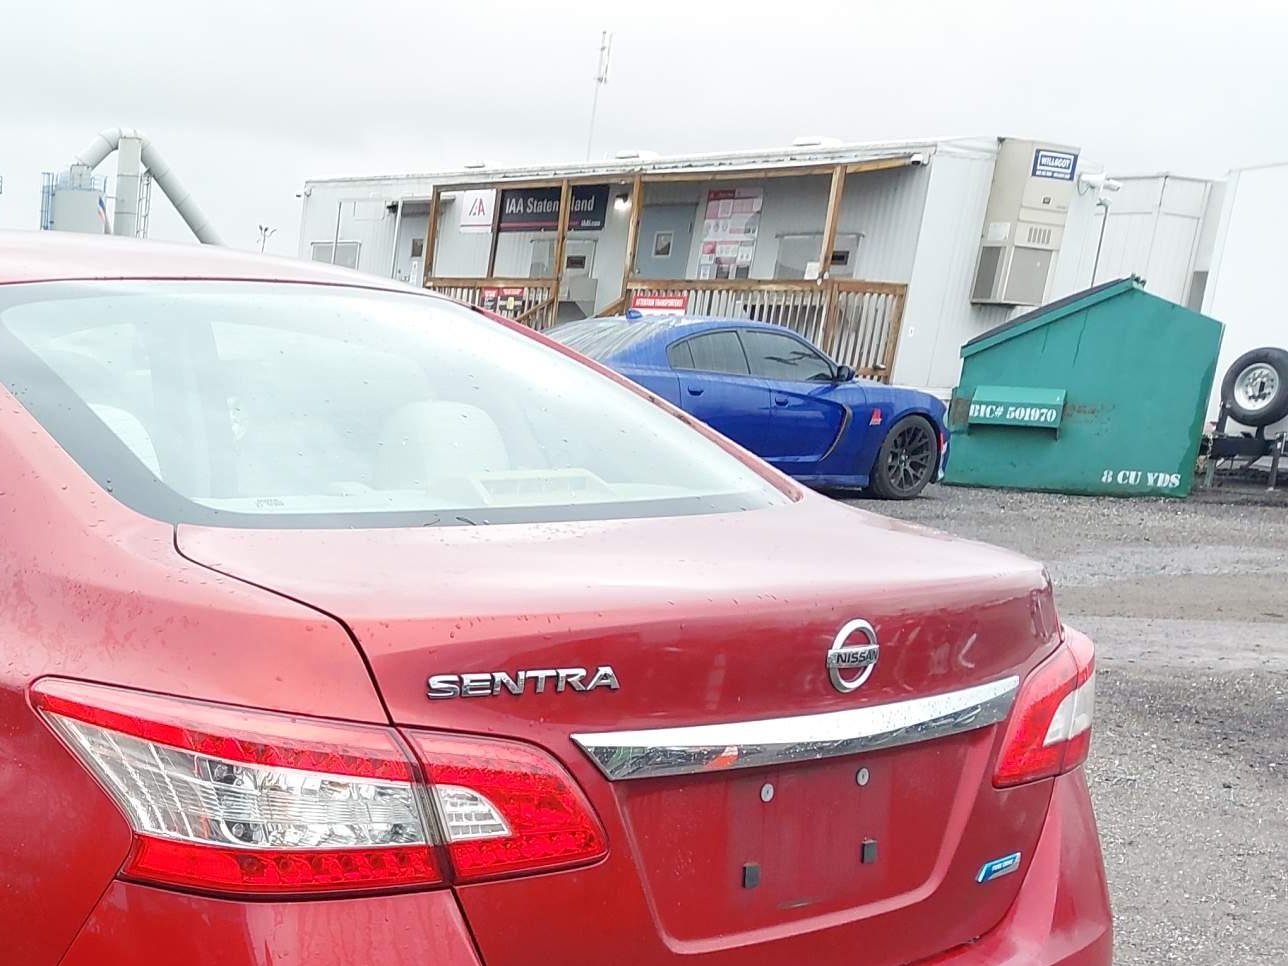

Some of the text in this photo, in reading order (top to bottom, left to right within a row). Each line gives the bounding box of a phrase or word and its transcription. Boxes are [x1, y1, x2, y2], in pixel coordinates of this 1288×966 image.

[505, 198, 524, 214] IAA
[527, 196, 560, 214] Staten
[969, 404, 1004, 418] BIC#
[1101, 469, 1181, 488] 8 CU YDS
[836, 649, 877, 664] NISSAN
[427, 666, 620, 700] SENTRA
